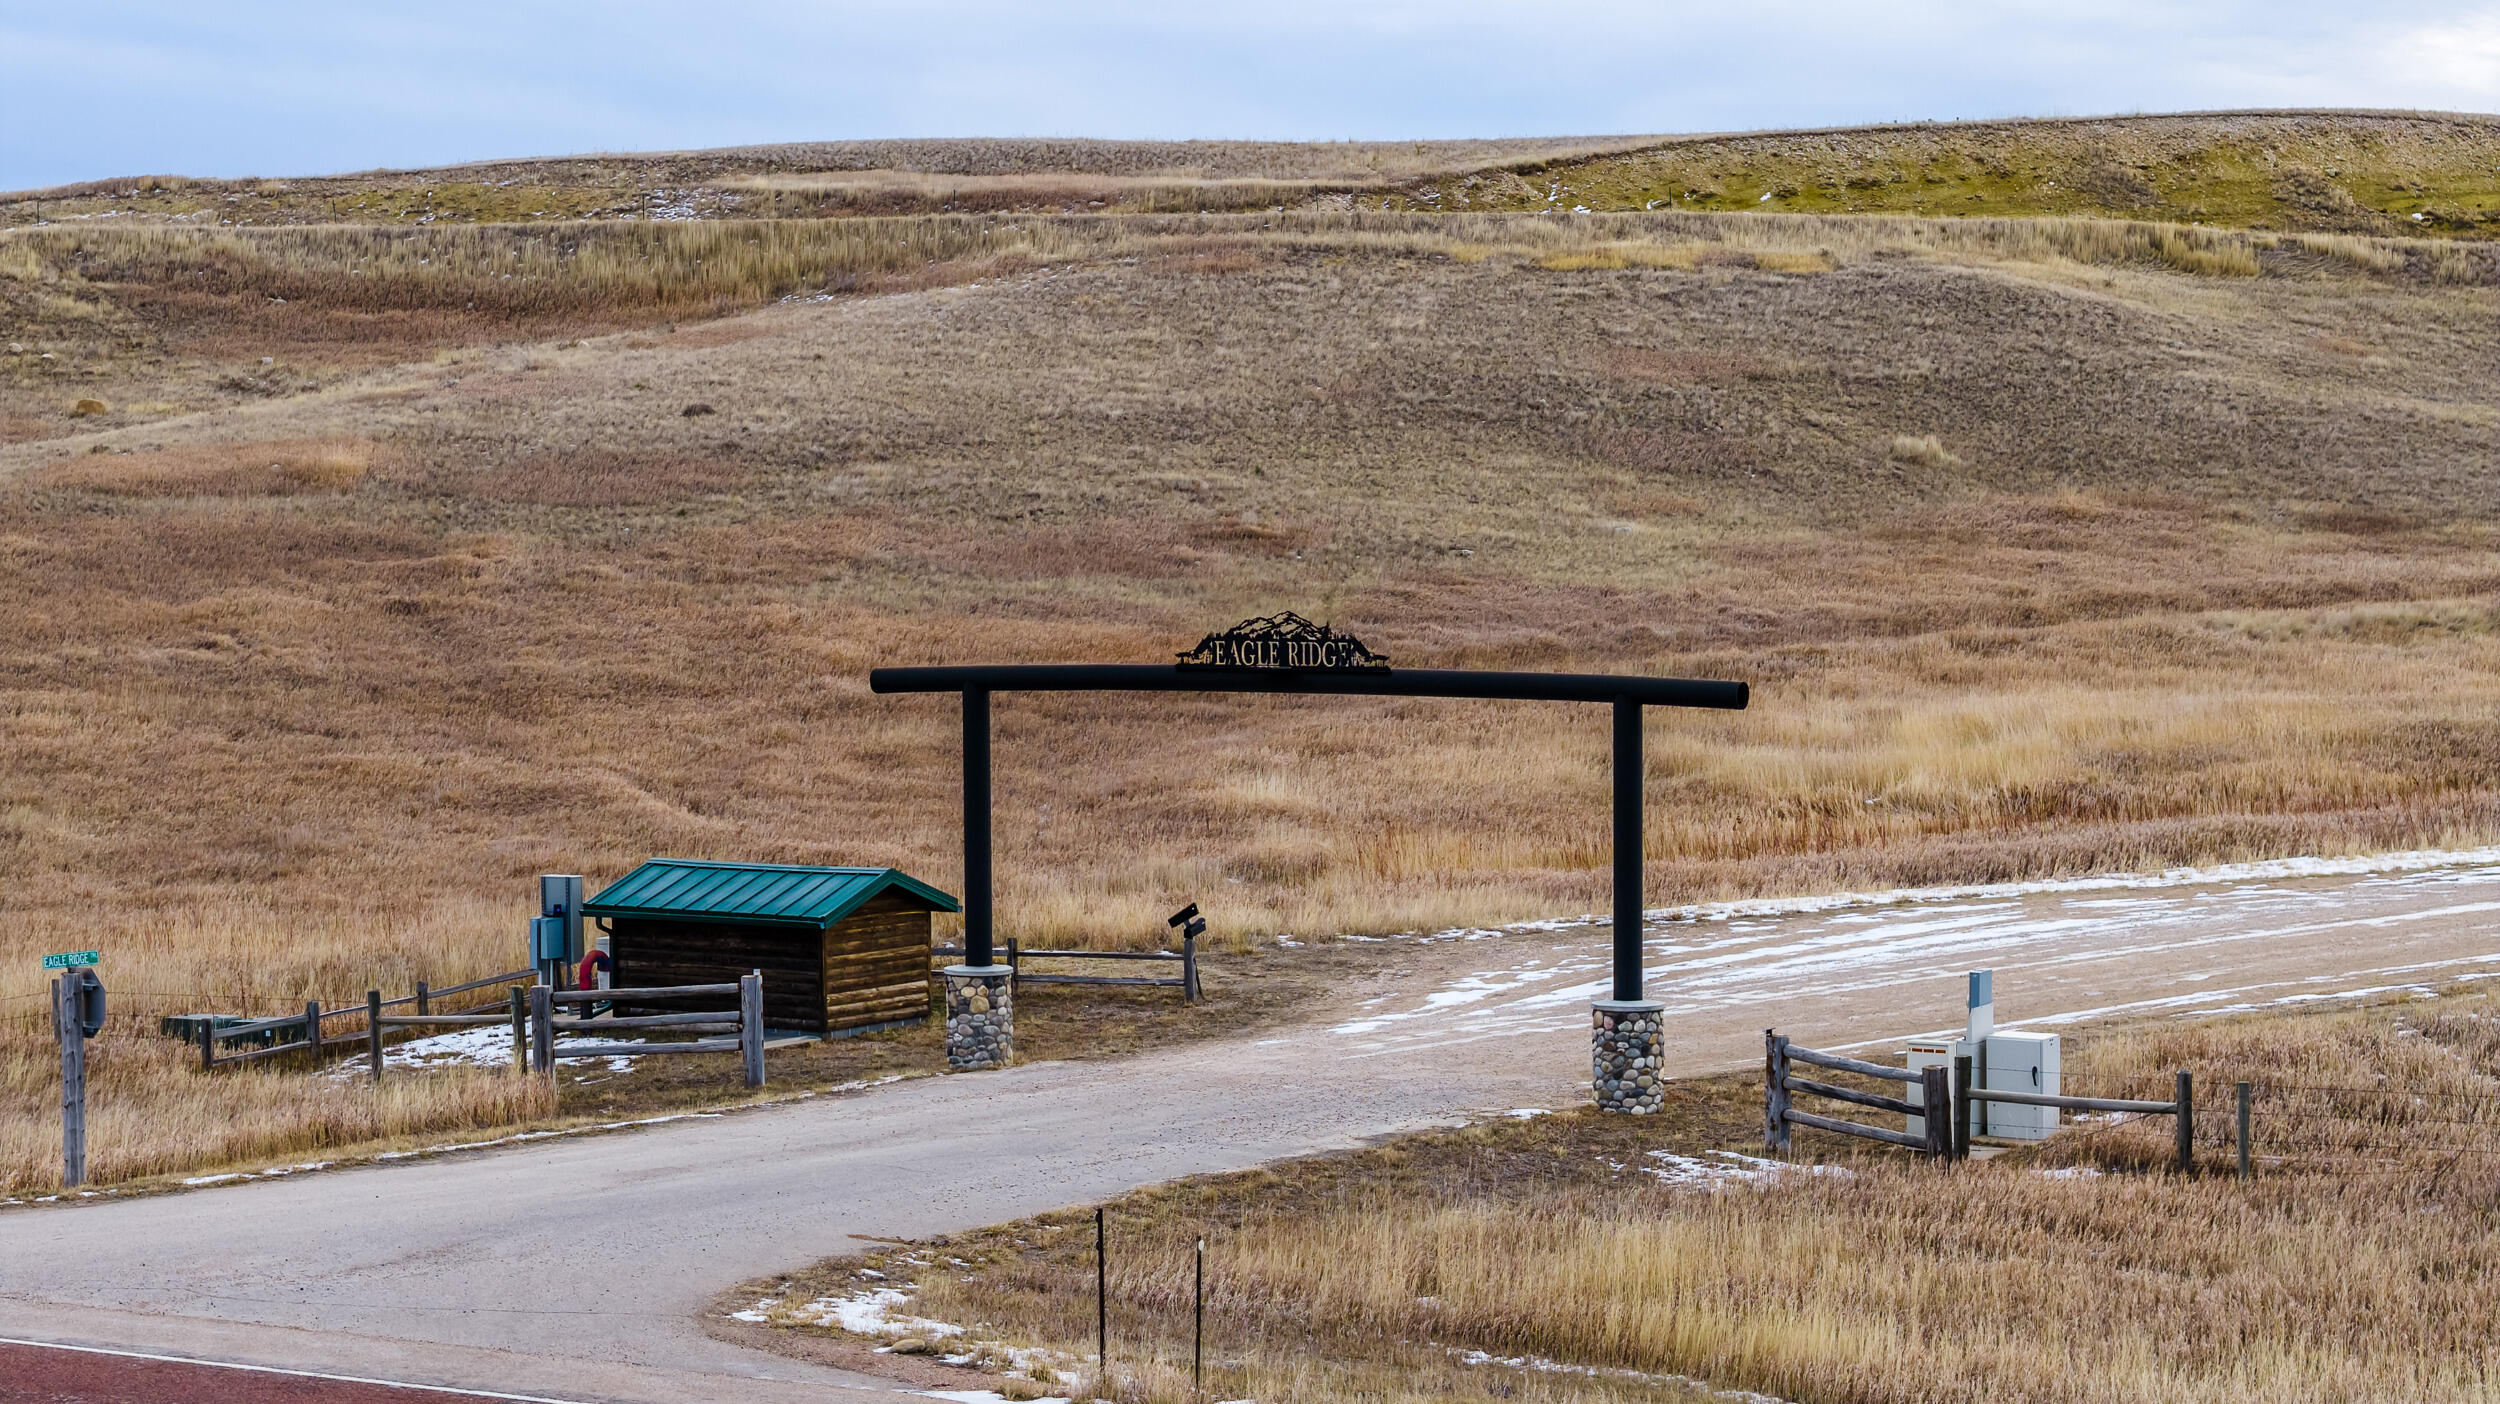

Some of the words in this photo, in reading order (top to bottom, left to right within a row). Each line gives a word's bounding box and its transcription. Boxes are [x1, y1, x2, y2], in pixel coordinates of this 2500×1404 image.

[1215, 640, 1280, 667] EAGLE
[1287, 641, 1349, 667] RIDGE
[44, 956, 66, 968] EAGLE
[68, 953, 88, 965] RIDGE
